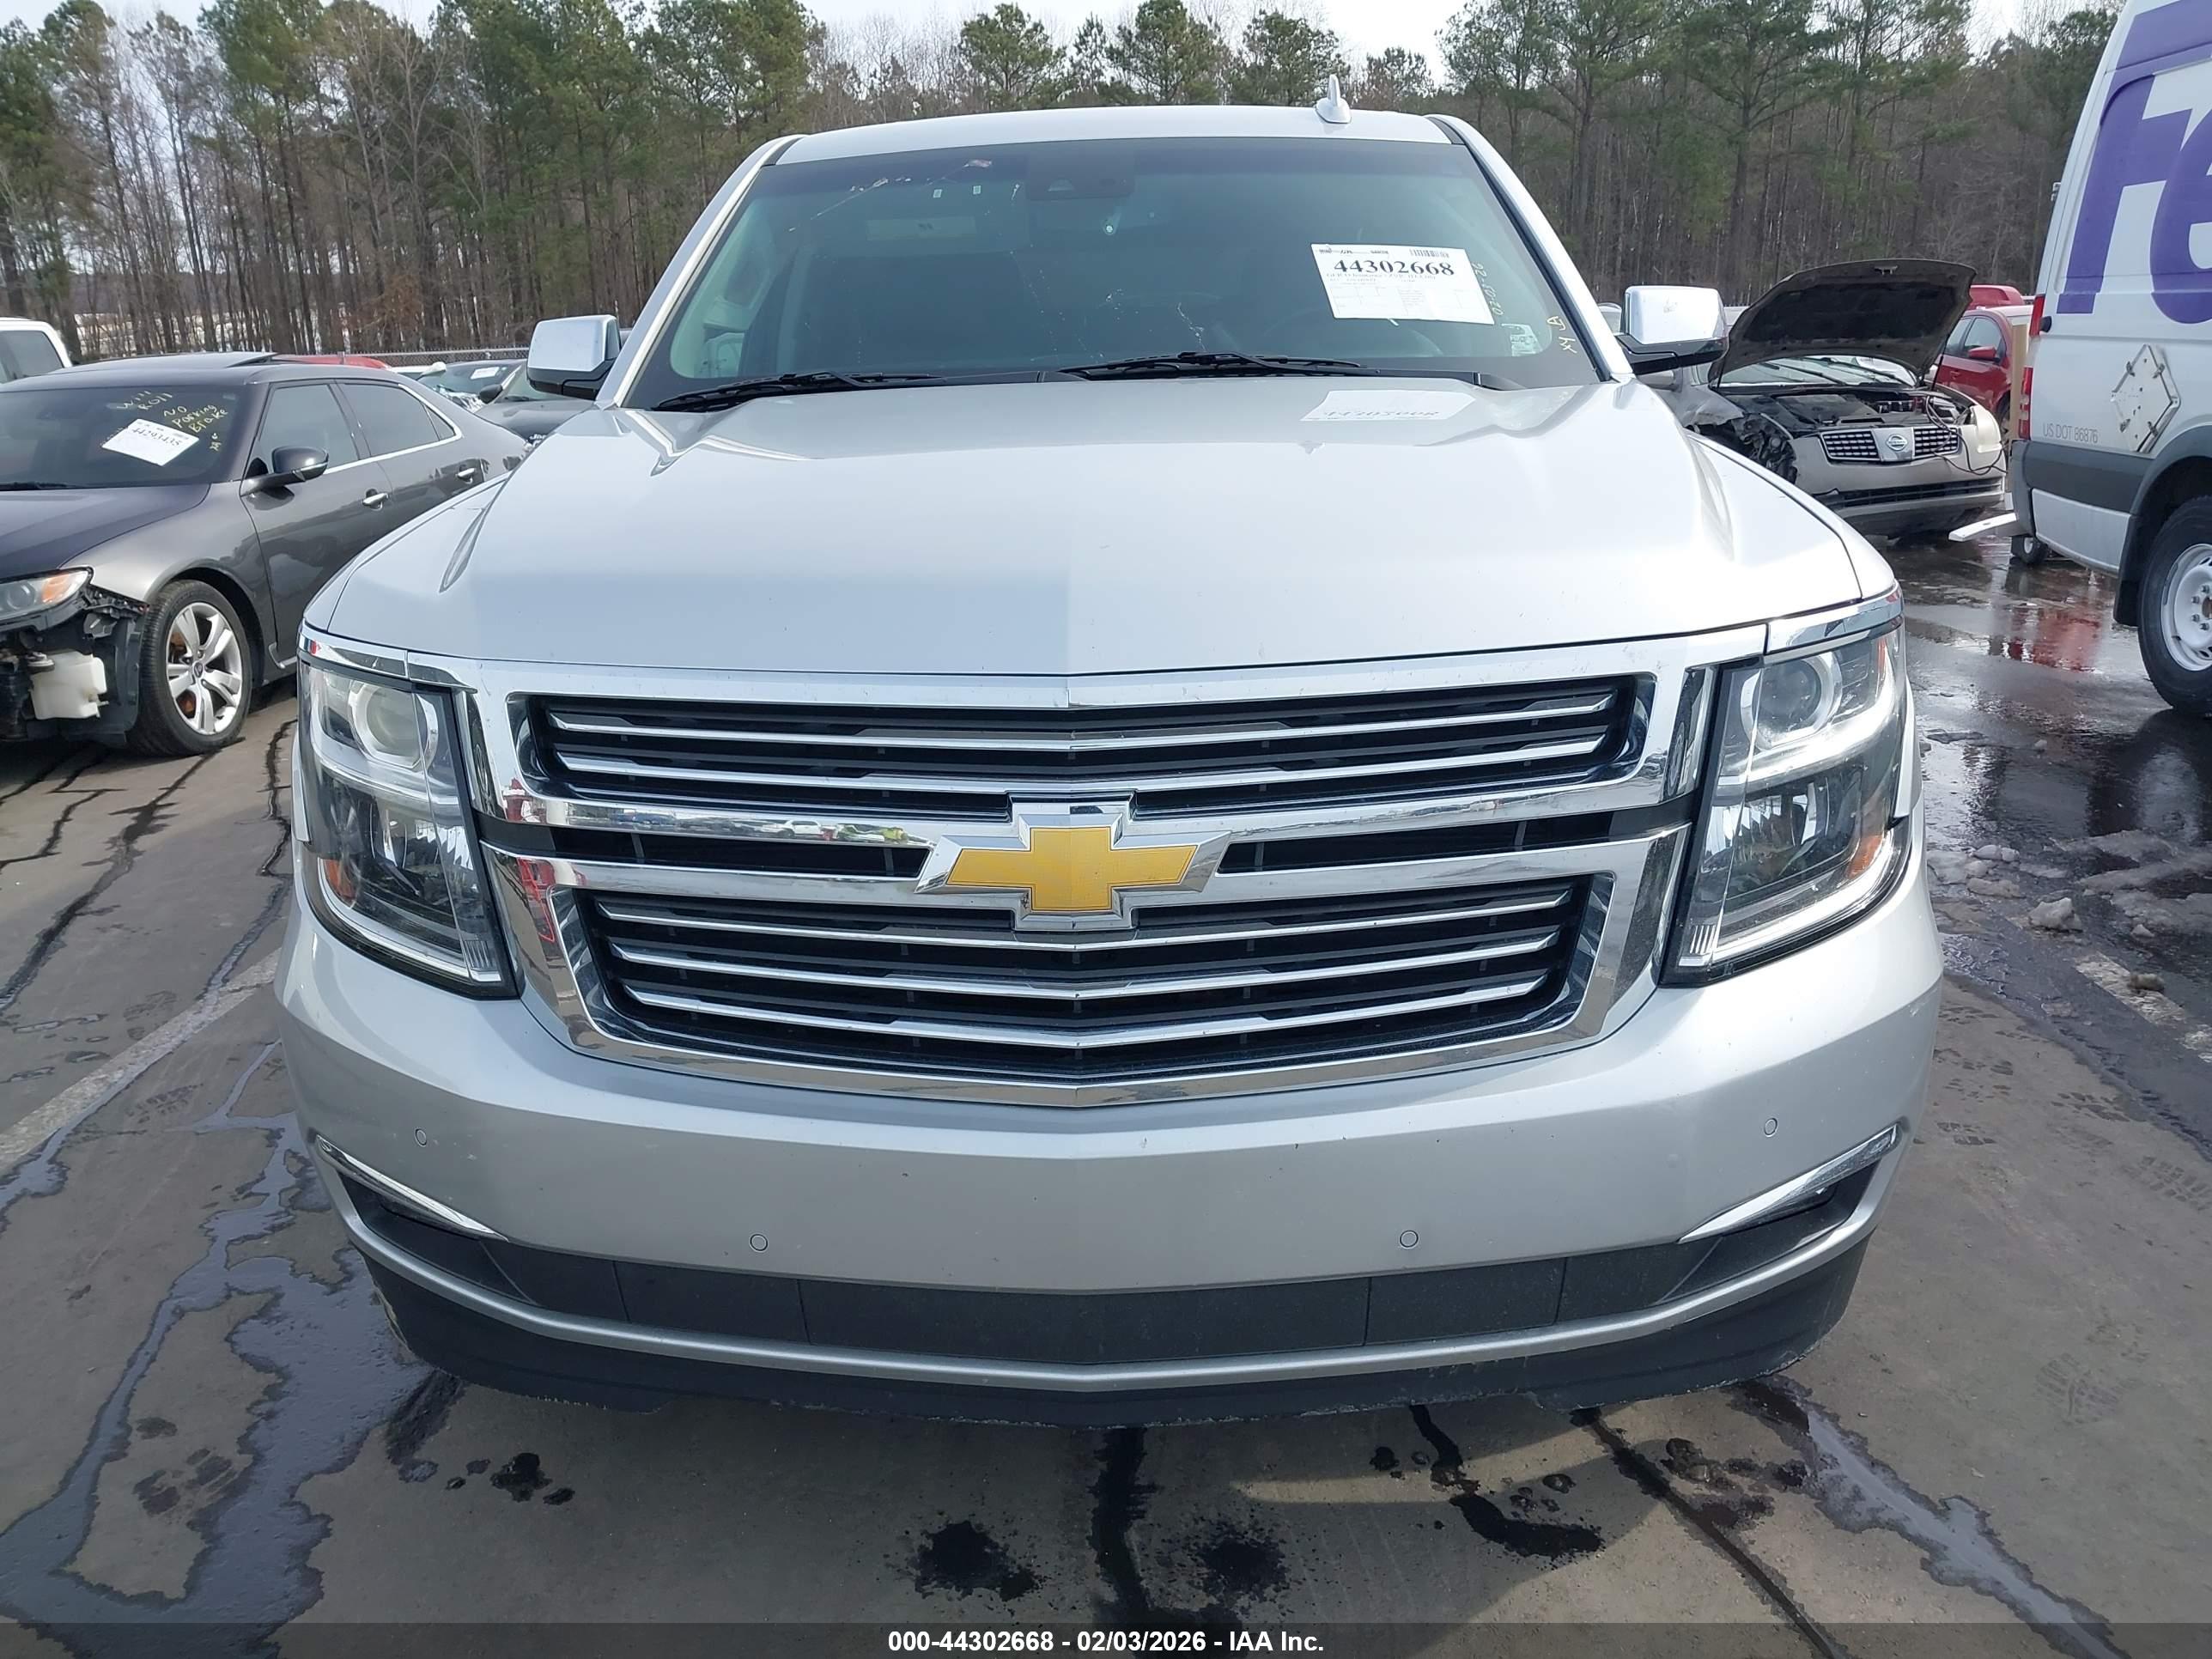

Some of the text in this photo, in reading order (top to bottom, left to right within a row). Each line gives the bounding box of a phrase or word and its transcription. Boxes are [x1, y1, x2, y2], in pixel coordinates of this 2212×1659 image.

[1334, 259, 1455, 276] 44302668
[2043, 422, 2054, 437] US
[2055, 424, 2072, 440] DOT
